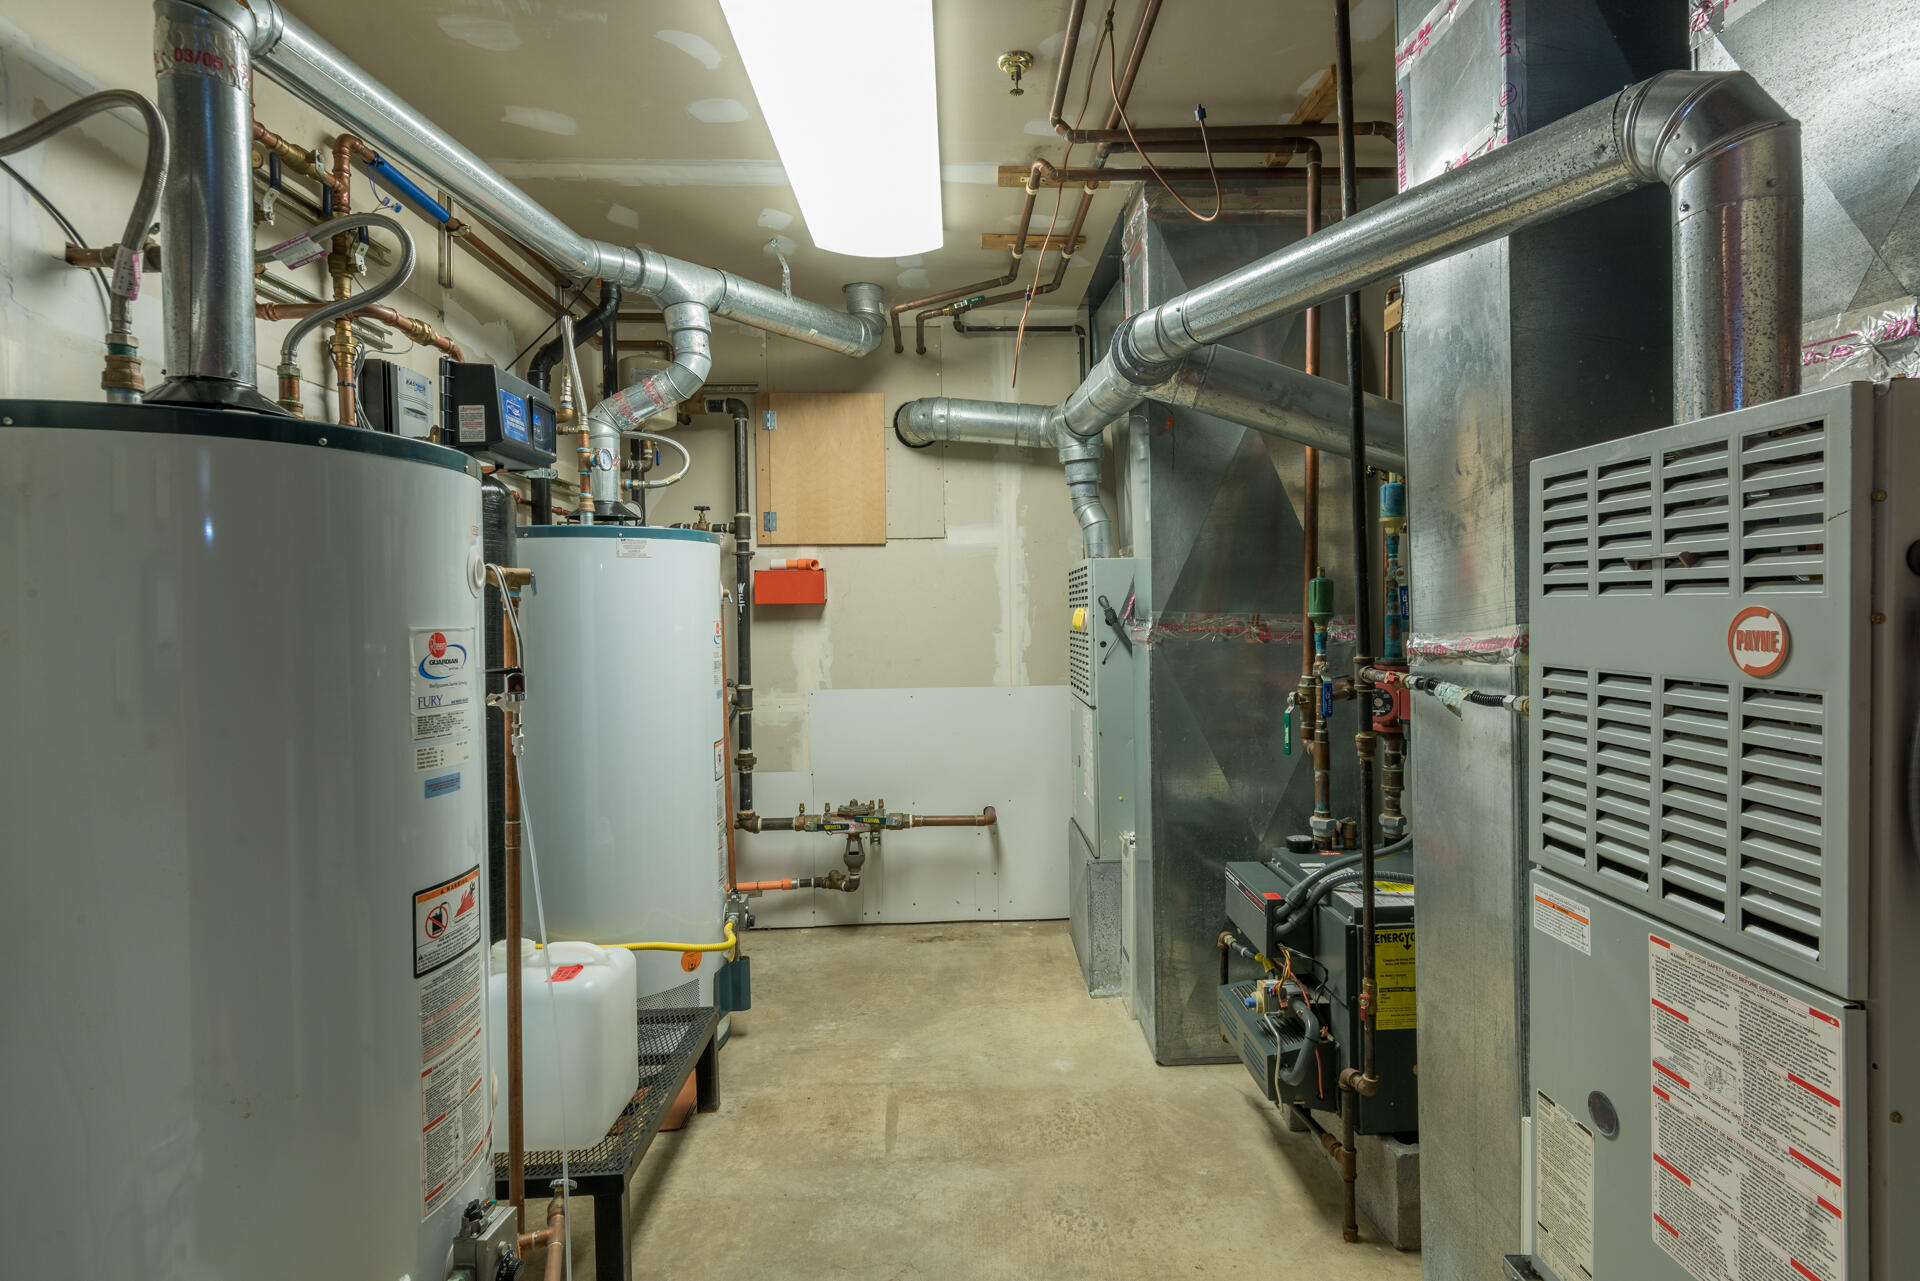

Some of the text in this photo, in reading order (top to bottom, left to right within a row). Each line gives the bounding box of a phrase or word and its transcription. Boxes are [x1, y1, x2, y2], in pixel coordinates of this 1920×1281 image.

[174, 47, 225, 71] 03/05
[1395, 88, 1405, 120] 2000
[1397, 126, 1406, 156] SEAL
[737, 582, 746, 614] WET
[1736, 629, 1780, 653] PAYNE
[428, 658, 459, 666] GUARDIAN
[418, 695, 443, 709] FURY
